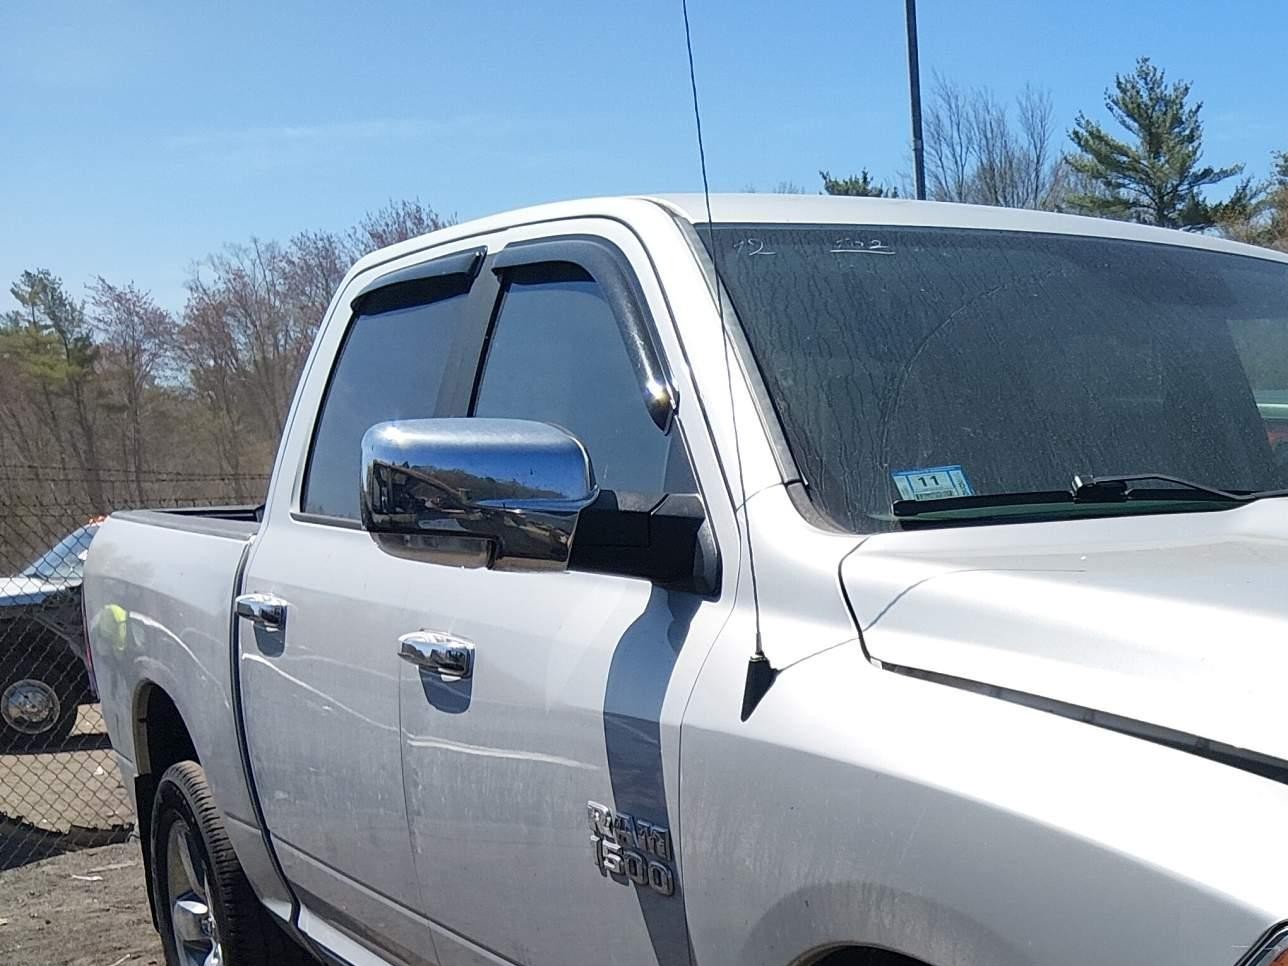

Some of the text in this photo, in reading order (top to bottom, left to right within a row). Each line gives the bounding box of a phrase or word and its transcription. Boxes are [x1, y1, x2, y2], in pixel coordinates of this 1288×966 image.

[917, 475, 940, 487] 11
[586, 800, 671, 862] RAM
[590, 834, 676, 897] 1500
